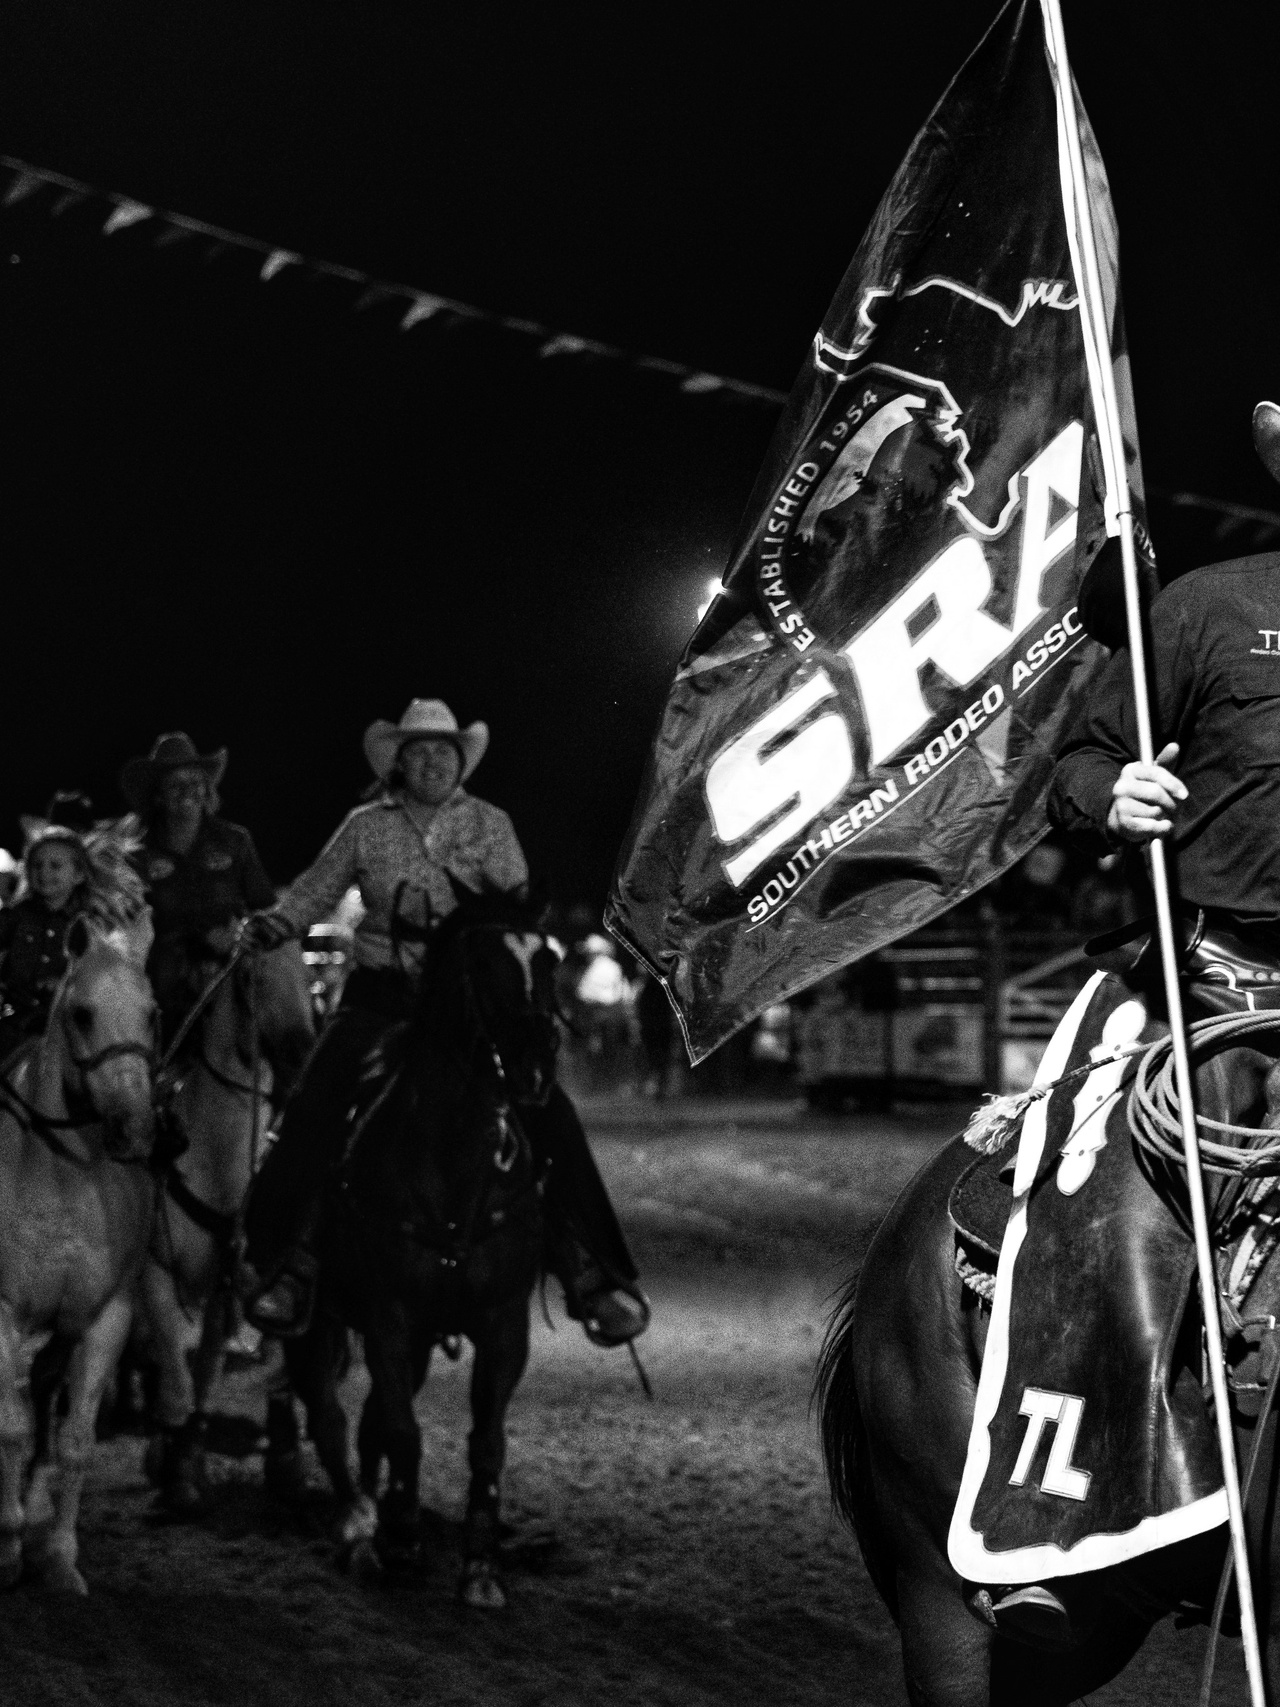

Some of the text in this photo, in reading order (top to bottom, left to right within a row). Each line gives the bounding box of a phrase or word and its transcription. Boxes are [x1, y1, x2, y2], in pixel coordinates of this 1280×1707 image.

[760, 389, 878, 651] ESTABLISHED 1954
[706, 420, 1084, 887] SRA
[747, 779, 899, 923] SOUTHERN
[903, 684, 1004, 785] RODEO
[1008, 1386, 1093, 1501] TL
